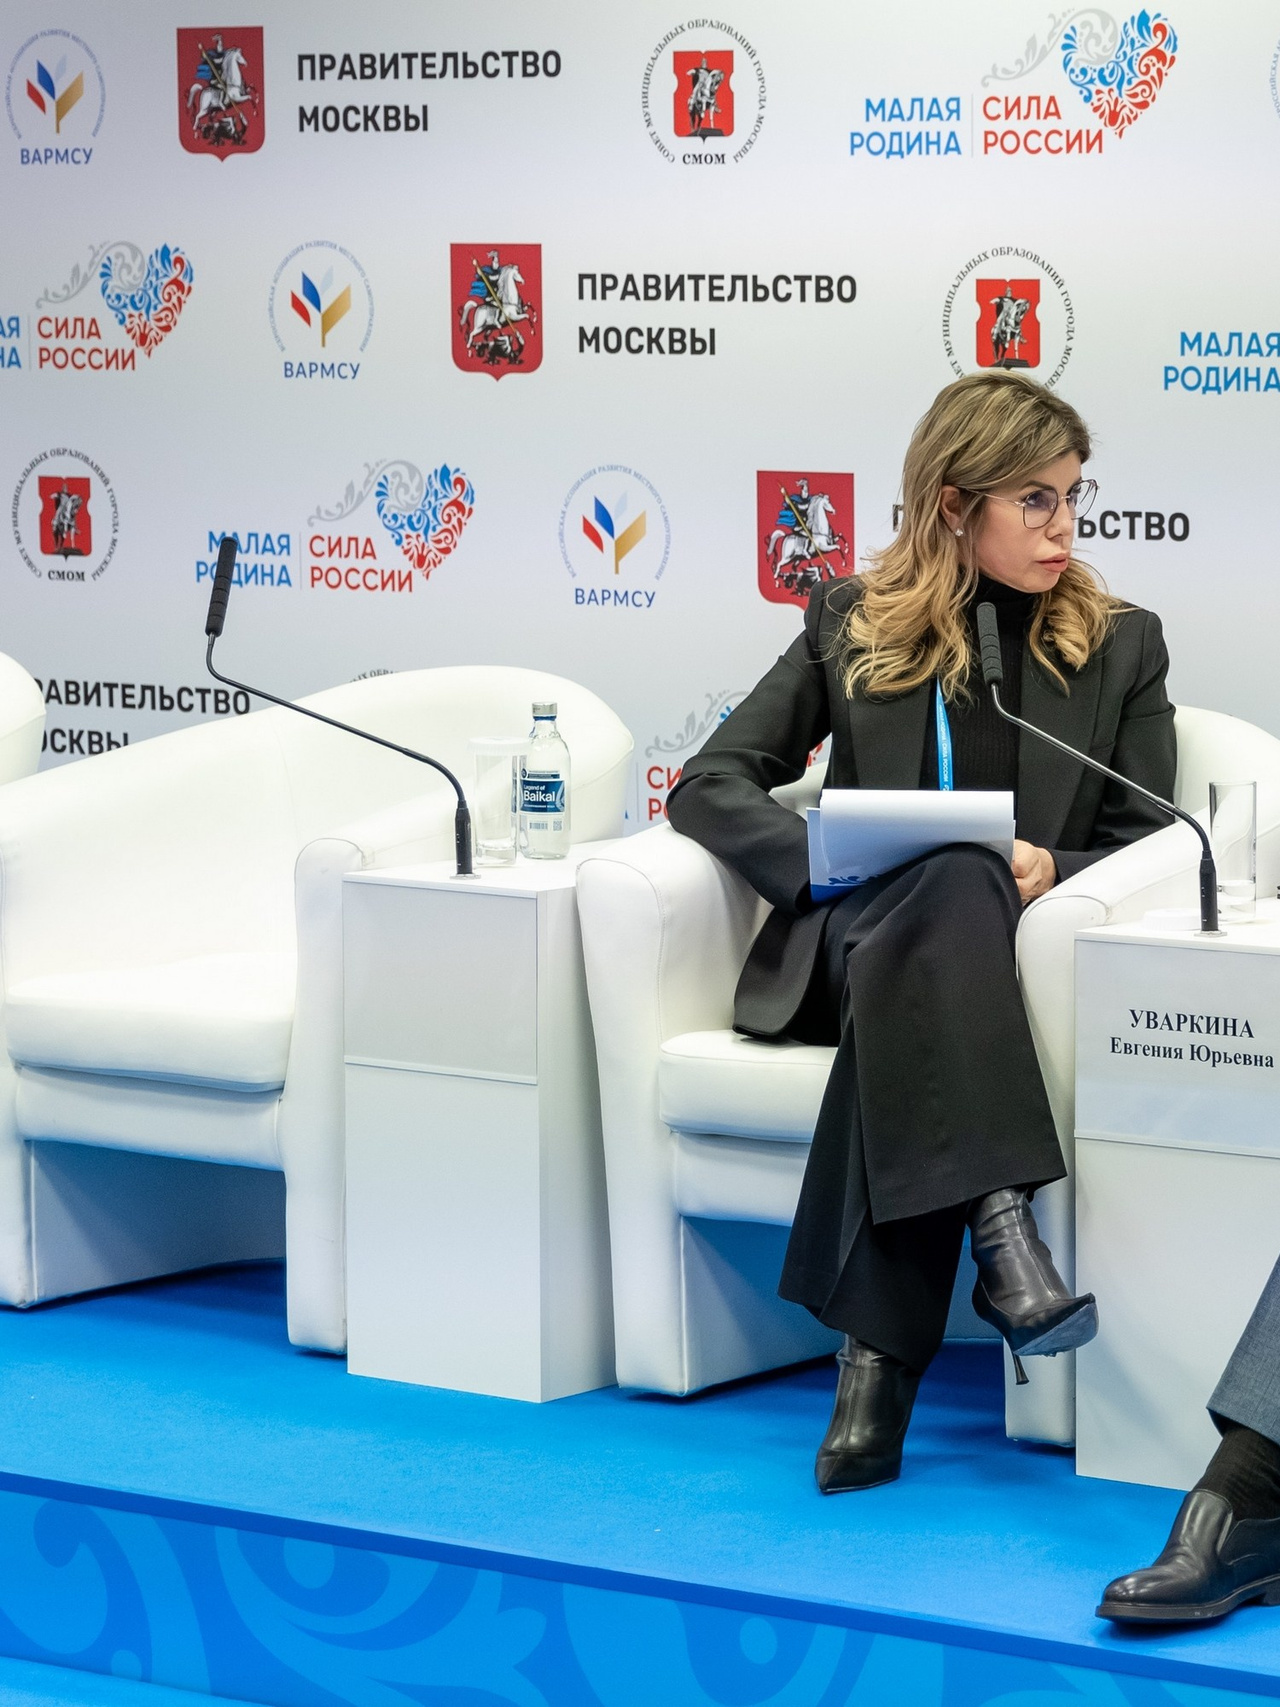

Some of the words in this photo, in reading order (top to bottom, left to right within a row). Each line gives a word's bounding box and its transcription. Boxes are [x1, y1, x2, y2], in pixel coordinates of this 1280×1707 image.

[298, 50, 561, 80] ПРАВИТЕЛЬСТВО
[688, 19, 757, 59] ОБРАЗОВАНИЙ
[753, 60, 766, 111] ГОРОДА
[299, 105, 428, 132] МОСКВЫ
[866, 97, 960, 122] МАЛАЯ
[983, 96, 1061, 121] СИЛА
[21, 148, 92, 164] ВАРМСУ
[850, 131, 961, 159] РОДИНА
[984, 129, 1102, 154] РОССИИ
[683, 154, 725, 164] СМОМ
[578, 274, 856, 303] ПРАВИТЕЛЬСТВО
[942, 251, 990, 358] МУНИЦИПАЛЬНЫХ
[991, 246, 1064, 289] ОБРАЗОВАНИЙ
[1061, 290, 1075, 342] ГОРОДА
[38, 316, 101, 339] СИЛА
[579, 326, 715, 355] МОСКВЫ
[1181, 332, 1280, 357] МАЛАЯ
[39, 347, 136, 371] РОССИИ
[284, 362, 359, 379] ВАРМСУ
[310, 535, 376, 559] СИЛА
[48, 571, 84, 581] СМОМ
[311, 563, 416, 592] РОССИИ
[575, 588, 655, 608] ВАРМСУ
[524, 790, 556, 802] Baikal
[1129, 1009, 1255, 1038] УВАРКИНА
[1110, 1036, 1184, 1060] Евгения
[1189, 1044, 1274, 1068] Юрьевна
